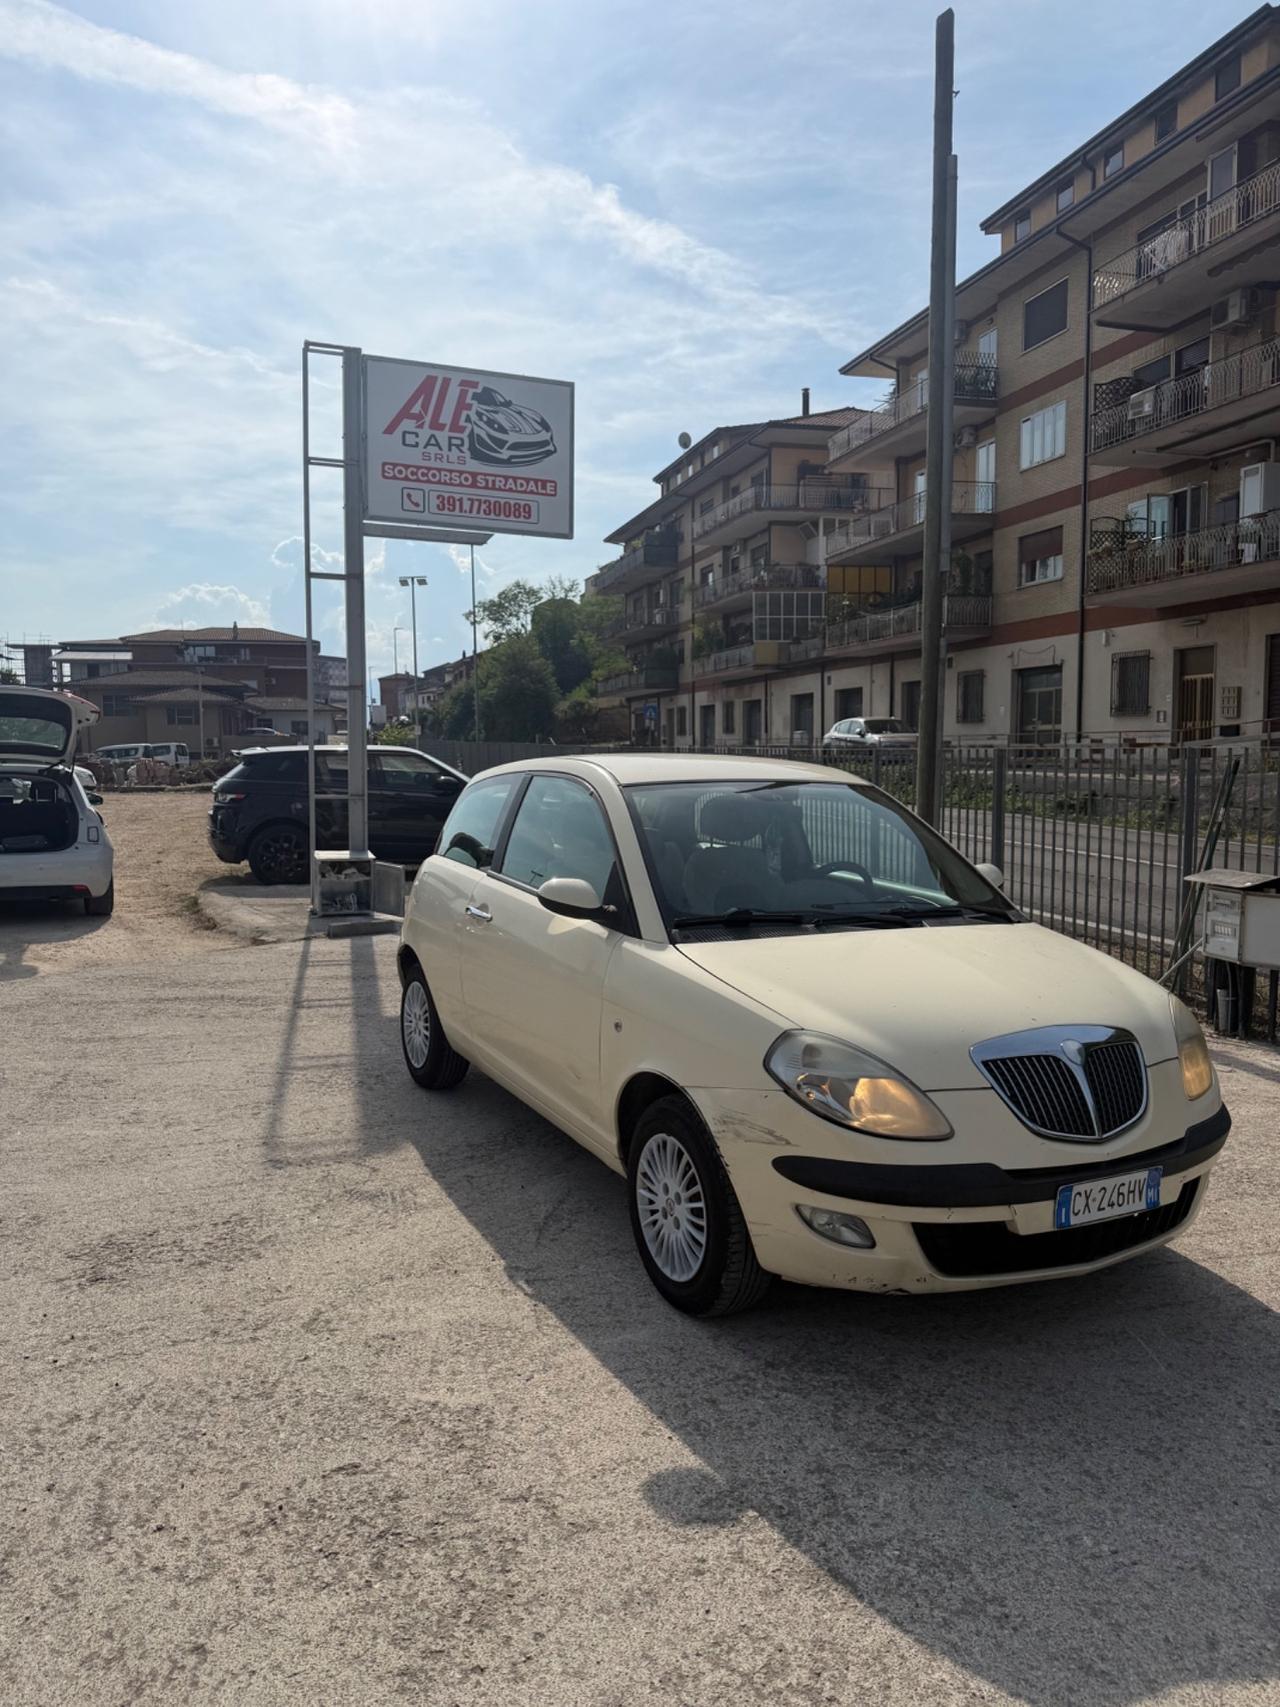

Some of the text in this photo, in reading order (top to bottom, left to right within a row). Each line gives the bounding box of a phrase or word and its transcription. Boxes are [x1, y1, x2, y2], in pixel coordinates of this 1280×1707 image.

[383, 375, 479, 434] ALE
[402, 431, 465, 453] CAR
[422, 452, 466, 465] SRLS
[384, 465, 555, 494] SOCCORSO STRADALE
[436, 494, 532, 519] 391.7730089
